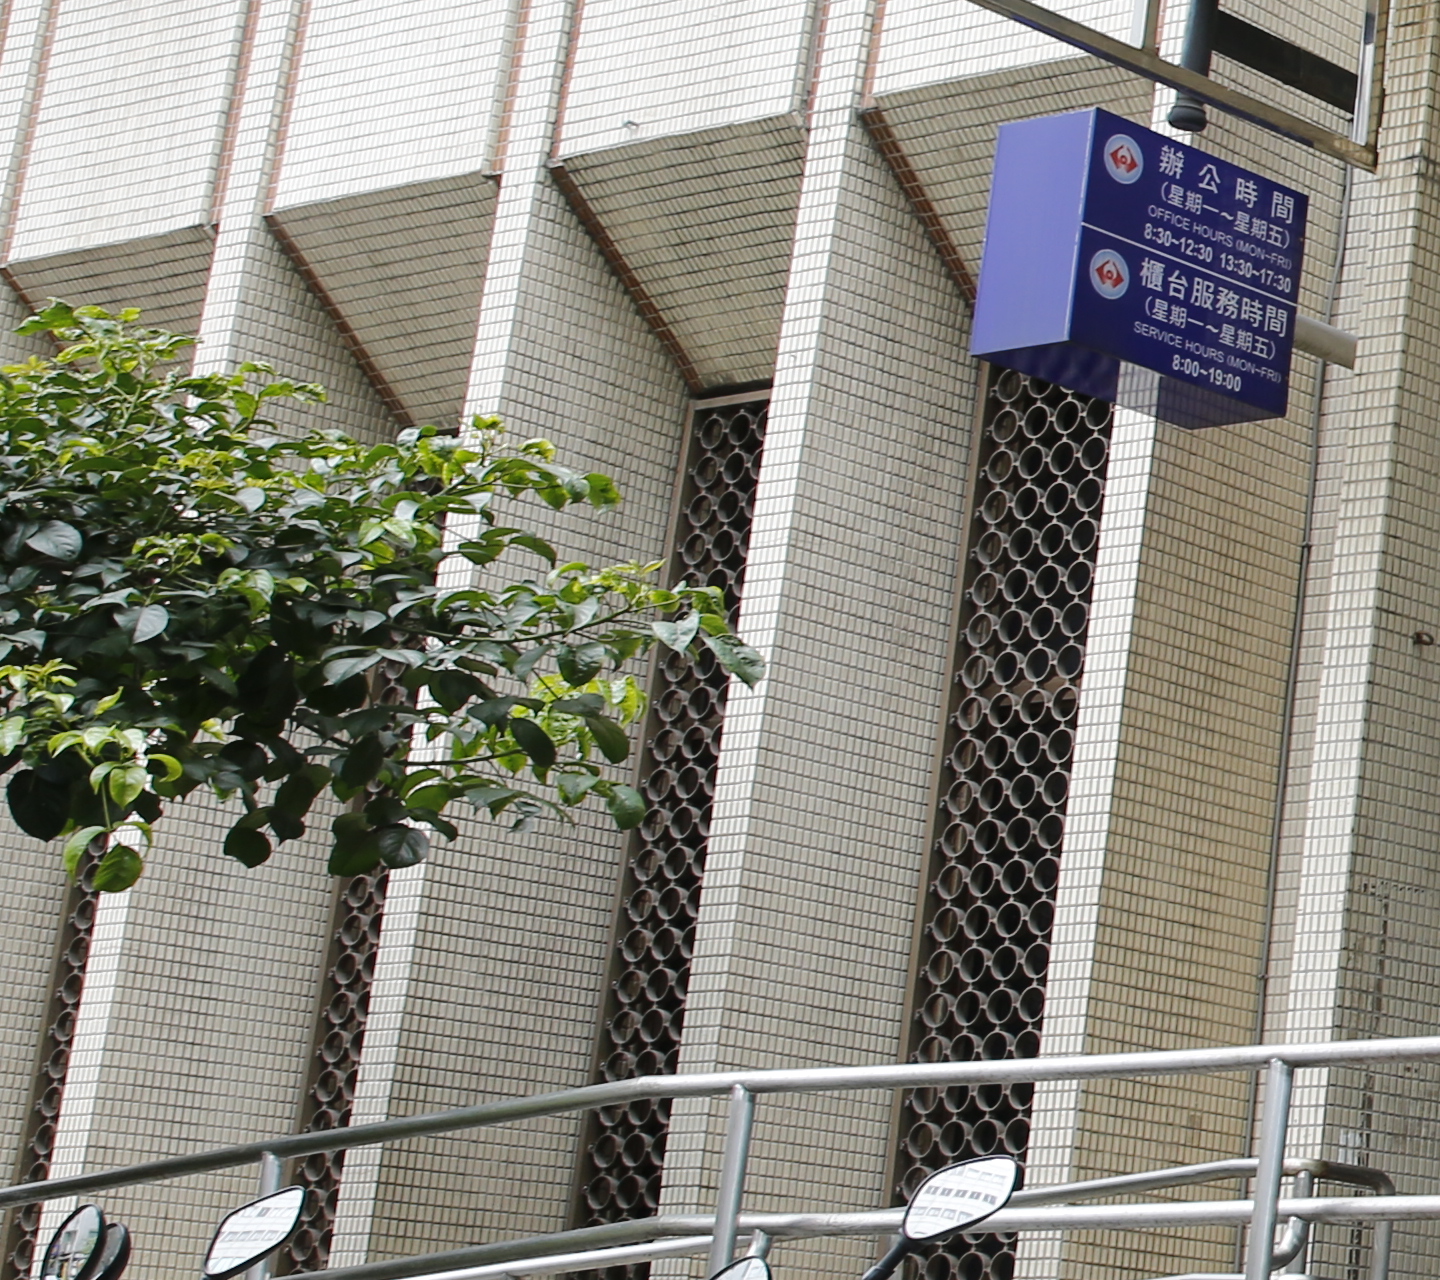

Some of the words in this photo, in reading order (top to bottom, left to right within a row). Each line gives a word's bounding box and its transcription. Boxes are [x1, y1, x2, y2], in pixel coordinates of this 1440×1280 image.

[1159, 144, 1295, 225] 辦公時間
[1147, 204, 1191, 231] OFFICE
[1192, 221, 1234, 248] HOURS
[1139, 257, 1289, 338] 櫃台服務時間
[1133, 320, 1183, 349] SERVICE
[1184, 339, 1225, 364] HOURS
